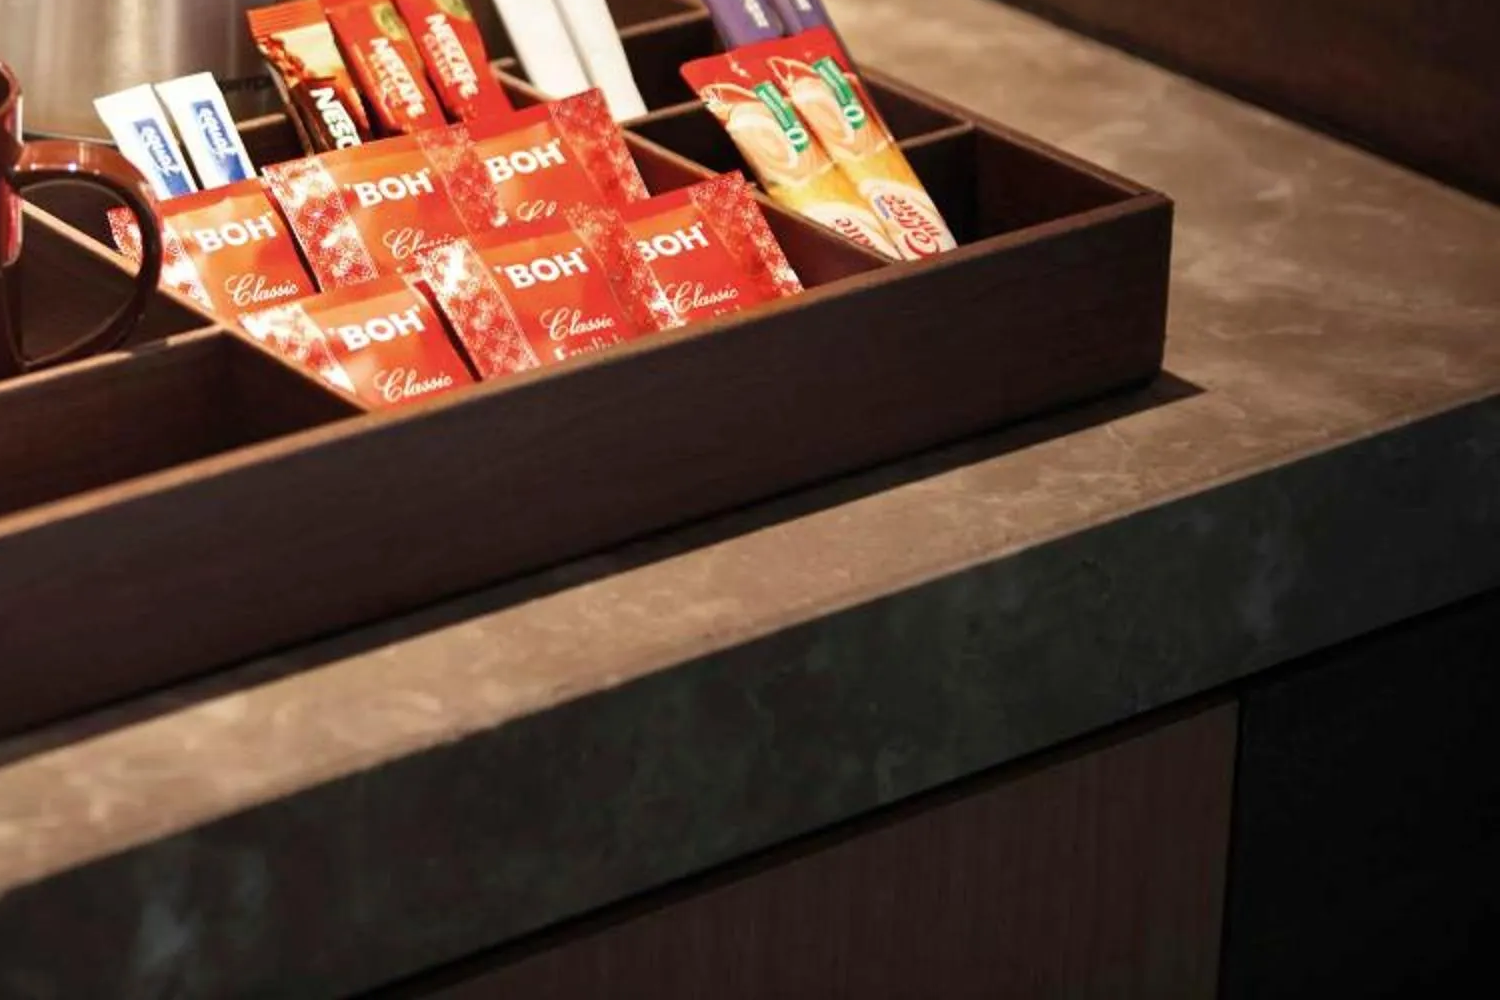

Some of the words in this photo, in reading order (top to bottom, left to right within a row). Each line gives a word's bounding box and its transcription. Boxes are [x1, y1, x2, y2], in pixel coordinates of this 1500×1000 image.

[484, 138, 567, 184] BOH
[353, 168, 435, 208] BOH
[193, 213, 277, 253] BOH
[503, 247, 590, 289] BOH
[225, 274, 300, 307] Classic
[664, 281, 740, 315] Classic
[337, 304, 427, 352] BOH
[540, 306, 616, 342] Classic
[373, 367, 454, 402] Classic
